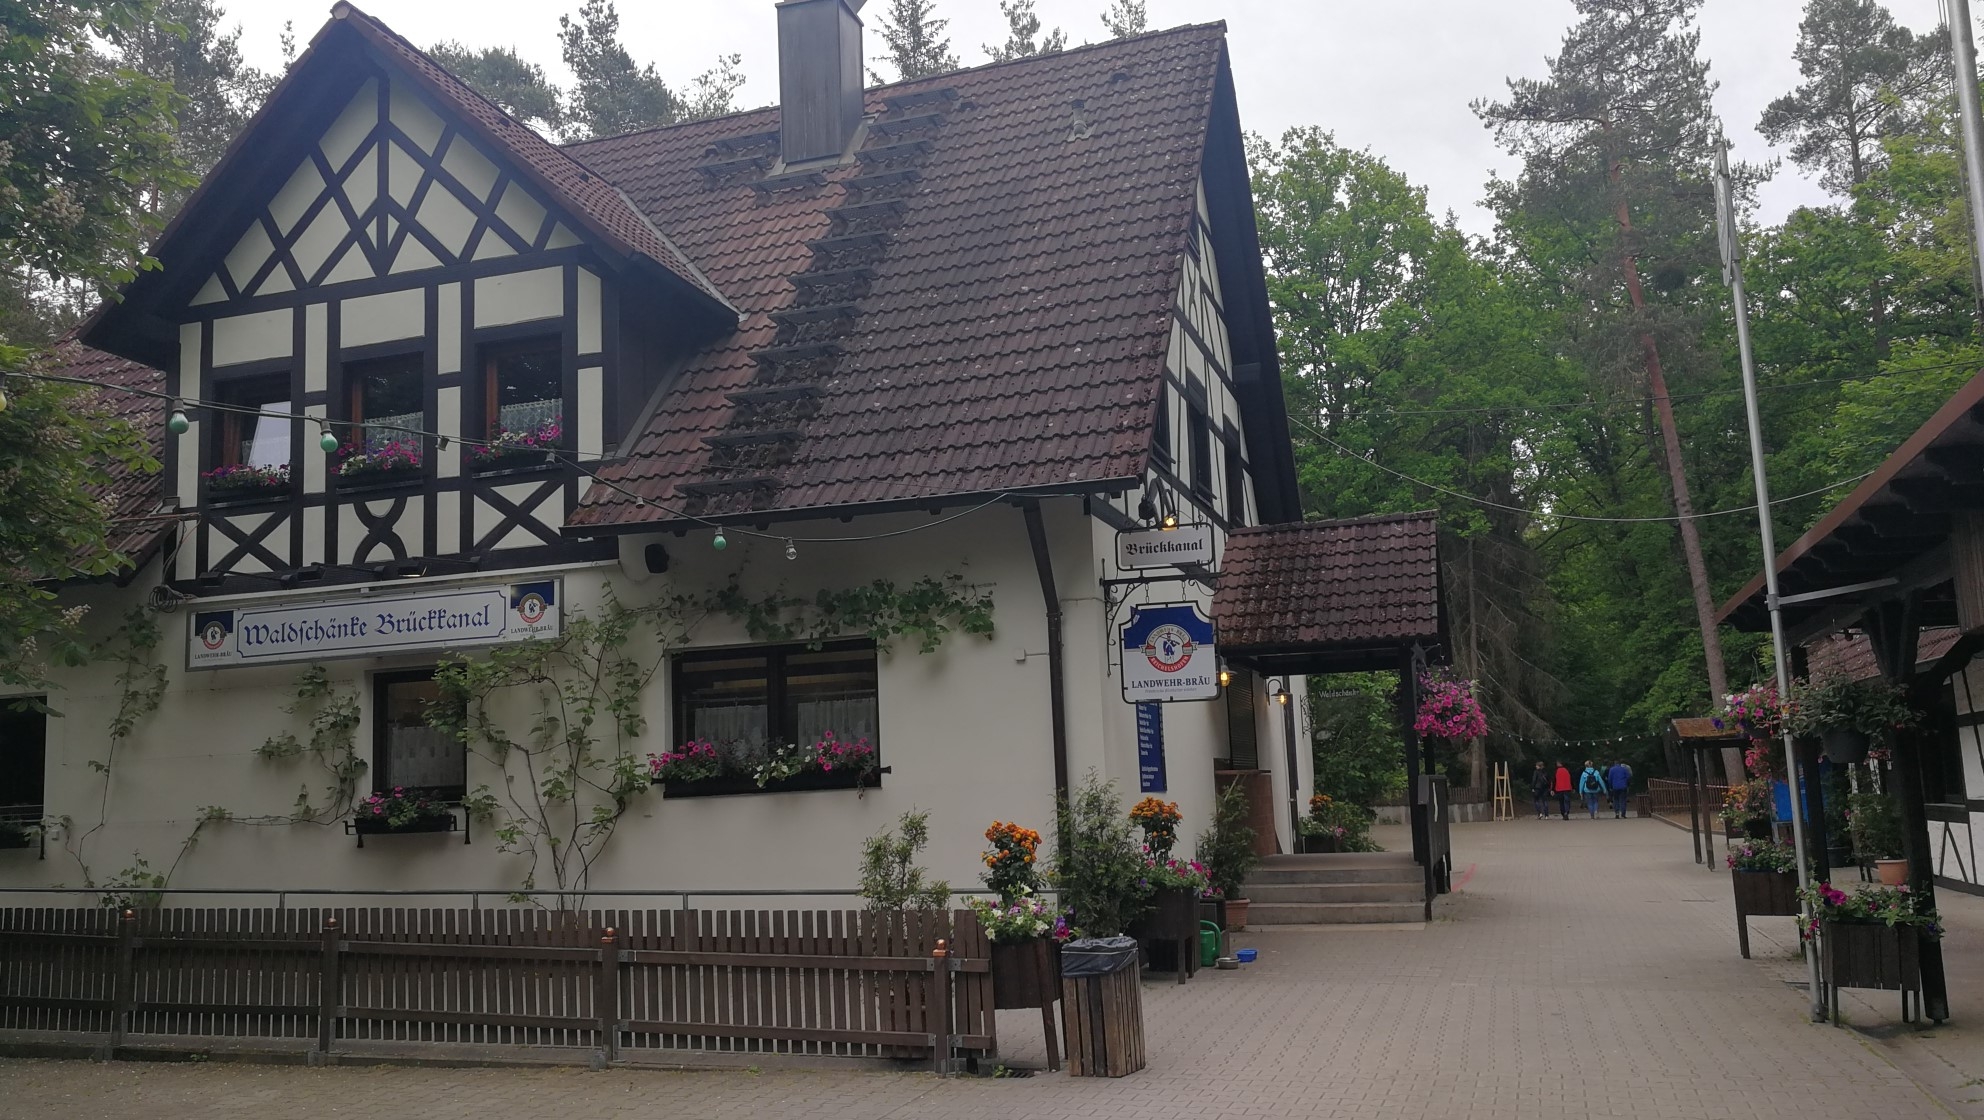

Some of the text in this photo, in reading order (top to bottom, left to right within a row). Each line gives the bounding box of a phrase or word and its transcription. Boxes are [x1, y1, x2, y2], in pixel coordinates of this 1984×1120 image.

[1125, 538, 1204, 555] Brückkanal
[374, 603, 491, 635] Brückkanal
[1131, 676, 1211, 689] LANDWEHR-BRÄU
